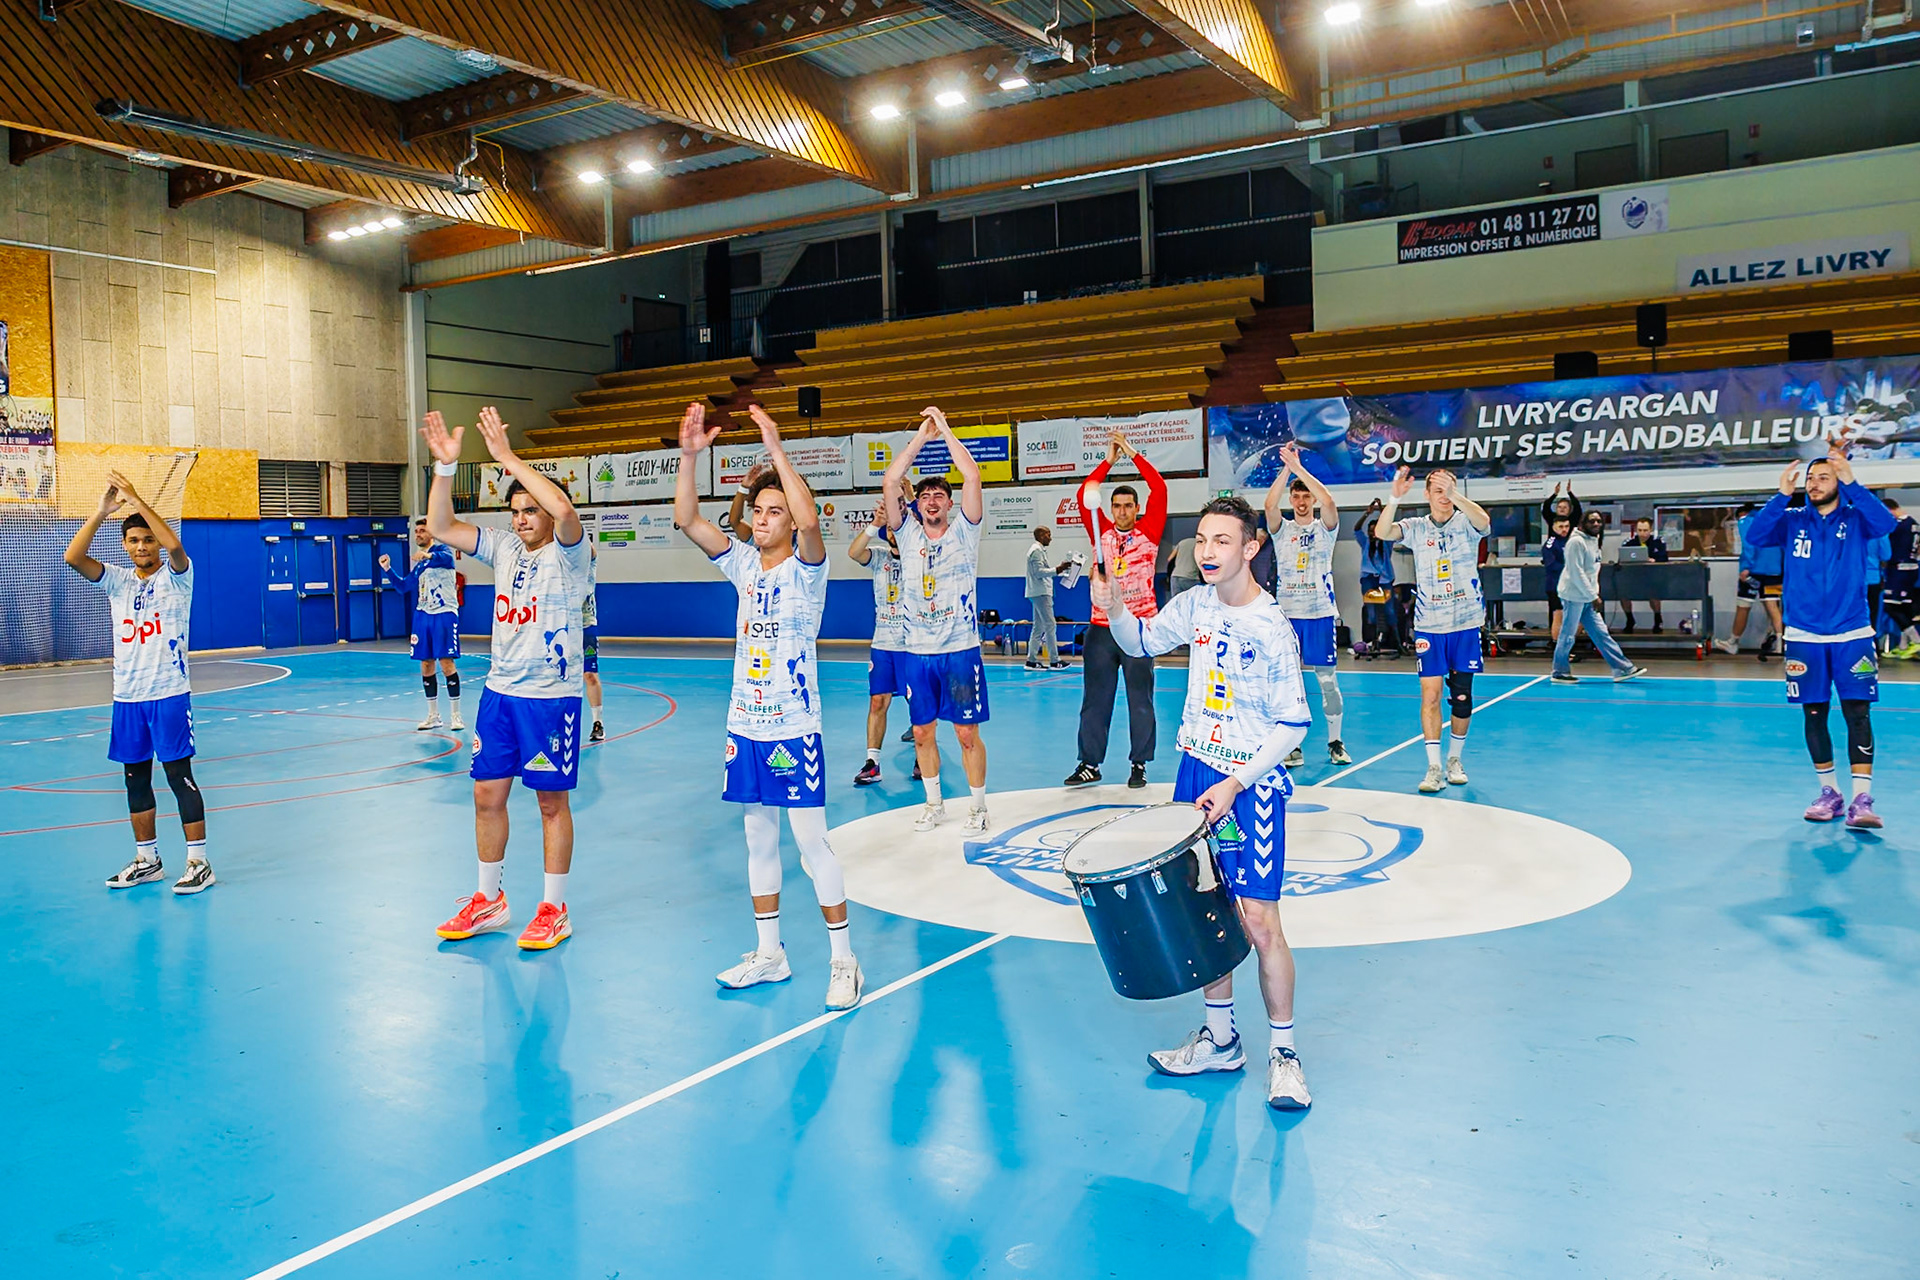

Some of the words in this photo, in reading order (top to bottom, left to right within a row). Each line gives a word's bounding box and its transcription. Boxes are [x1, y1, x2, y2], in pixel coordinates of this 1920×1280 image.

[1421, 219, 1477, 241] EDGAR
[1480, 217, 1498, 236] 01
[1503, 213, 1523, 233] 48
[1529, 211, 1546, 229] 11
[1551, 207, 1570, 226] 27
[1576, 202, 1597, 222] 70
[1400, 241, 1467, 260] IMPRESSION
[1470, 236, 1510, 252] OFFSET
[1513, 235, 1522, 247] &
[1526, 224, 1598, 246] NUMÉRIQUE
[1689, 260, 1786, 287] ALLEZ
[1796, 248, 1892, 276] LIVRY
[1477, 389, 1719, 428] LIVRY-GARGAN
[1026, 441, 1058, 452] SOCATEB
[1160, 434, 1195, 442] TERRASSES
[1361, 435, 1510, 465] SOUTIENT
[1515, 431, 1573, 457] SES
[1582, 414, 1864, 453] HANDBALLEURS
[1083, 452, 1093, 461] 01
[1095, 451, 1106, 460] 48
[529, 461, 557, 472] SCUS
[627, 457, 681, 478] LEROY-MER
[1793, 539, 1812, 558] 30
[496, 594, 538, 632] Orpi
[1215, 815, 1231, 833] ROY
[1286, 873, 1348, 885] DE
